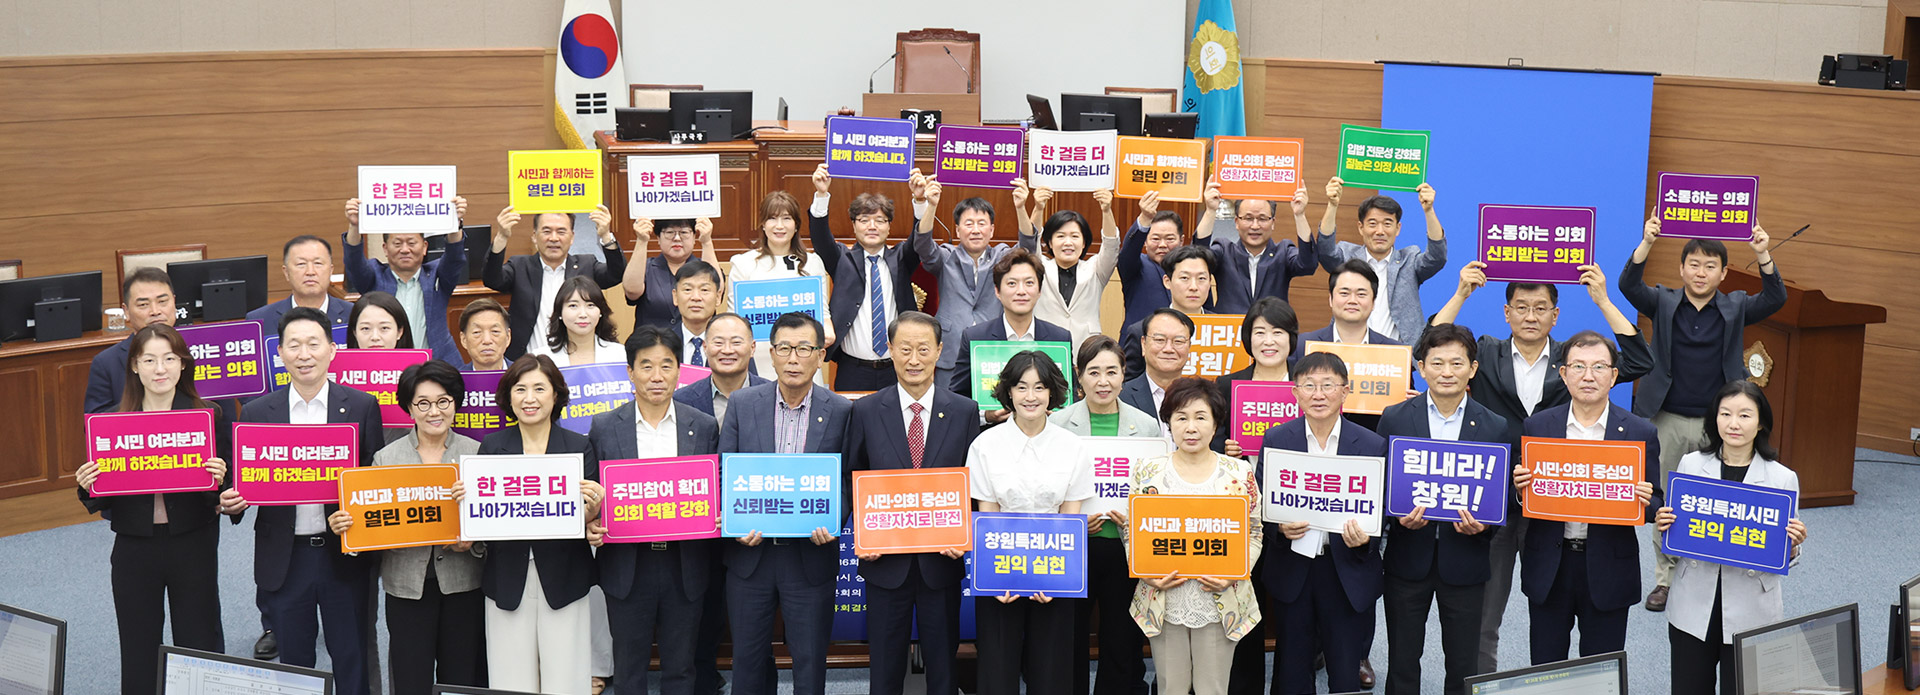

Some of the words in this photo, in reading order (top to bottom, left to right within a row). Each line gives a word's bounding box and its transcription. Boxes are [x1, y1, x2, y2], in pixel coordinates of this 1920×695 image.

[832, 132, 844, 145] 늘
[845, 133, 866, 146] 시민
[868, 135, 910, 149] 여러분과
[942, 140, 990, 156] 소통하는
[994, 142, 1018, 157] 의회
[831, 149, 851, 162] 함께
[854, 151, 907, 164] 하겠습니다.
[1041, 145, 1055, 161] 한
[1059, 145, 1087, 162] 걸음
[1092, 145, 1104, 161] 더
[1347, 143, 1366, 157] 입법
[1366, 145, 1393, 160] 전문성
[1394, 147, 1421, 161] 강화로
[941, 157, 989, 172] 신뢰받는
[993, 159, 1016, 174] 의회
[1123, 153, 1155, 167] 시민과
[1156, 154, 1198, 169] 함께하는
[1265, 155, 1295, 168] 중심의
[1345, 158, 1372, 171] 질높은
[1373, 160, 1392, 173] 의정
[1392, 162, 1420, 175] 서비스
[518, 169, 549, 180] 시민과
[553, 168, 594, 179] 함께하는
[641, 172, 655, 187] 한
[660, 171, 688, 187] 걸음
[694, 171, 707, 186] 더
[1034, 163, 1110, 178] 나아가겠습니다
[1132, 169, 1157, 184] 열린
[1162, 170, 1188, 185] 의회
[1220, 168, 1271, 182] 생활자치로
[1273, 169, 1295, 183] 발전
[372, 183, 388, 199] 한
[393, 182, 422, 200] 걸음
[428, 183, 443, 198] 더
[527, 184, 554, 197] 열린
[559, 183, 585, 197] 의회
[636, 190, 714, 203] 나아가겠습니다
[1664, 189, 1718, 205] 소통하는
[1722, 191, 1750, 206] 의회
[366, 203, 450, 216] 나아가겠습니다
[1663, 207, 1717, 223] 신뢰받는
[1721, 208, 1748, 224] 의회
[1487, 224, 1549, 242] 소통하는
[1554, 226, 1585, 243] 의회
[1486, 245, 1548, 263] 신뢰받는
[1554, 247, 1585, 264] 의회
[742, 294, 789, 310] 소통하는
[792, 292, 816, 306] 의회
[745, 312, 781, 325] 신뢰받
[1191, 324, 1242, 347] 내라!
[188, 344, 220, 360] 하는
[225, 339, 256, 357] 의회
[194, 364, 222, 381] 받는
[226, 360, 258, 378] 의회
[340, 370, 367, 385] 시민
[370, 370, 402, 385] 여러
[1354, 362, 1402, 378] 함께하는
[568, 385, 582, 400] 민
[584, 380, 632, 397] 여러분과
[1360, 380, 1390, 396] 의회
[1242, 401, 1299, 418] 주민참여
[451, 412, 500, 429] 뢰받는
[96, 436, 110, 451] 늘
[115, 434, 144, 450] 시민
[148, 431, 206, 449] 여러분과
[242, 445, 256, 460] 늘
[260, 446, 289, 461] 시민
[292, 445, 350, 461] 여러분과
[96, 457, 127, 472] 함께
[130, 453, 206, 472] 하겠습니다.
[1094, 457, 1130, 478] 걸음
[1402, 448, 1497, 481] 힘내라!
[241, 466, 270, 483] 함께
[1279, 468, 1298, 489] 한
[1304, 472, 1342, 494] 걸음
[1349, 476, 1367, 494] 더
[1592, 464, 1634, 481] 중심의
[477, 476, 497, 498] 한
[503, 476, 541, 497] 걸음
[548, 476, 567, 496] 더
[612, 480, 674, 500] 주민참여
[678, 478, 708, 496] 확대
[732, 475, 795, 492] 소통하는
[800, 475, 831, 492] 의회
[1532, 480, 1604, 499] 생활자치로
[1604, 482, 1634, 501] 발전
[350, 488, 394, 506] 시민과
[396, 486, 452, 502] 함께하는
[921, 491, 960, 508] 중심의
[1270, 491, 1374, 515] 나아가겠습니다
[1411, 480, 1484, 512] 창원!
[469, 501, 577, 519] 나아가겠습니다
[613, 504, 644, 522] 의회
[646, 502, 678, 520] 역할
[680, 500, 710, 518] 강화
[732, 498, 794, 515] 신뢰받는
[800, 498, 830, 515] 의회
[1680, 494, 1780, 527] 창원특례시민
[364, 508, 400, 528] 열린
[406, 506, 442, 524] 의회
[864, 510, 934, 530] 생활자치로
[934, 508, 962, 528] 발전
[1139, 517, 1182, 534] 시민과
[1184, 517, 1240, 534] 함께하는
[984, 531, 1075, 551] 창원특례시민
[1688, 518, 1724, 542] 권익
[1729, 525, 1766, 550] 실현
[1152, 538, 1186, 556] 열린
[1192, 538, 1228, 556] 의회
[994, 555, 1028, 574] 권익
[1032, 555, 1066, 575] 실현
